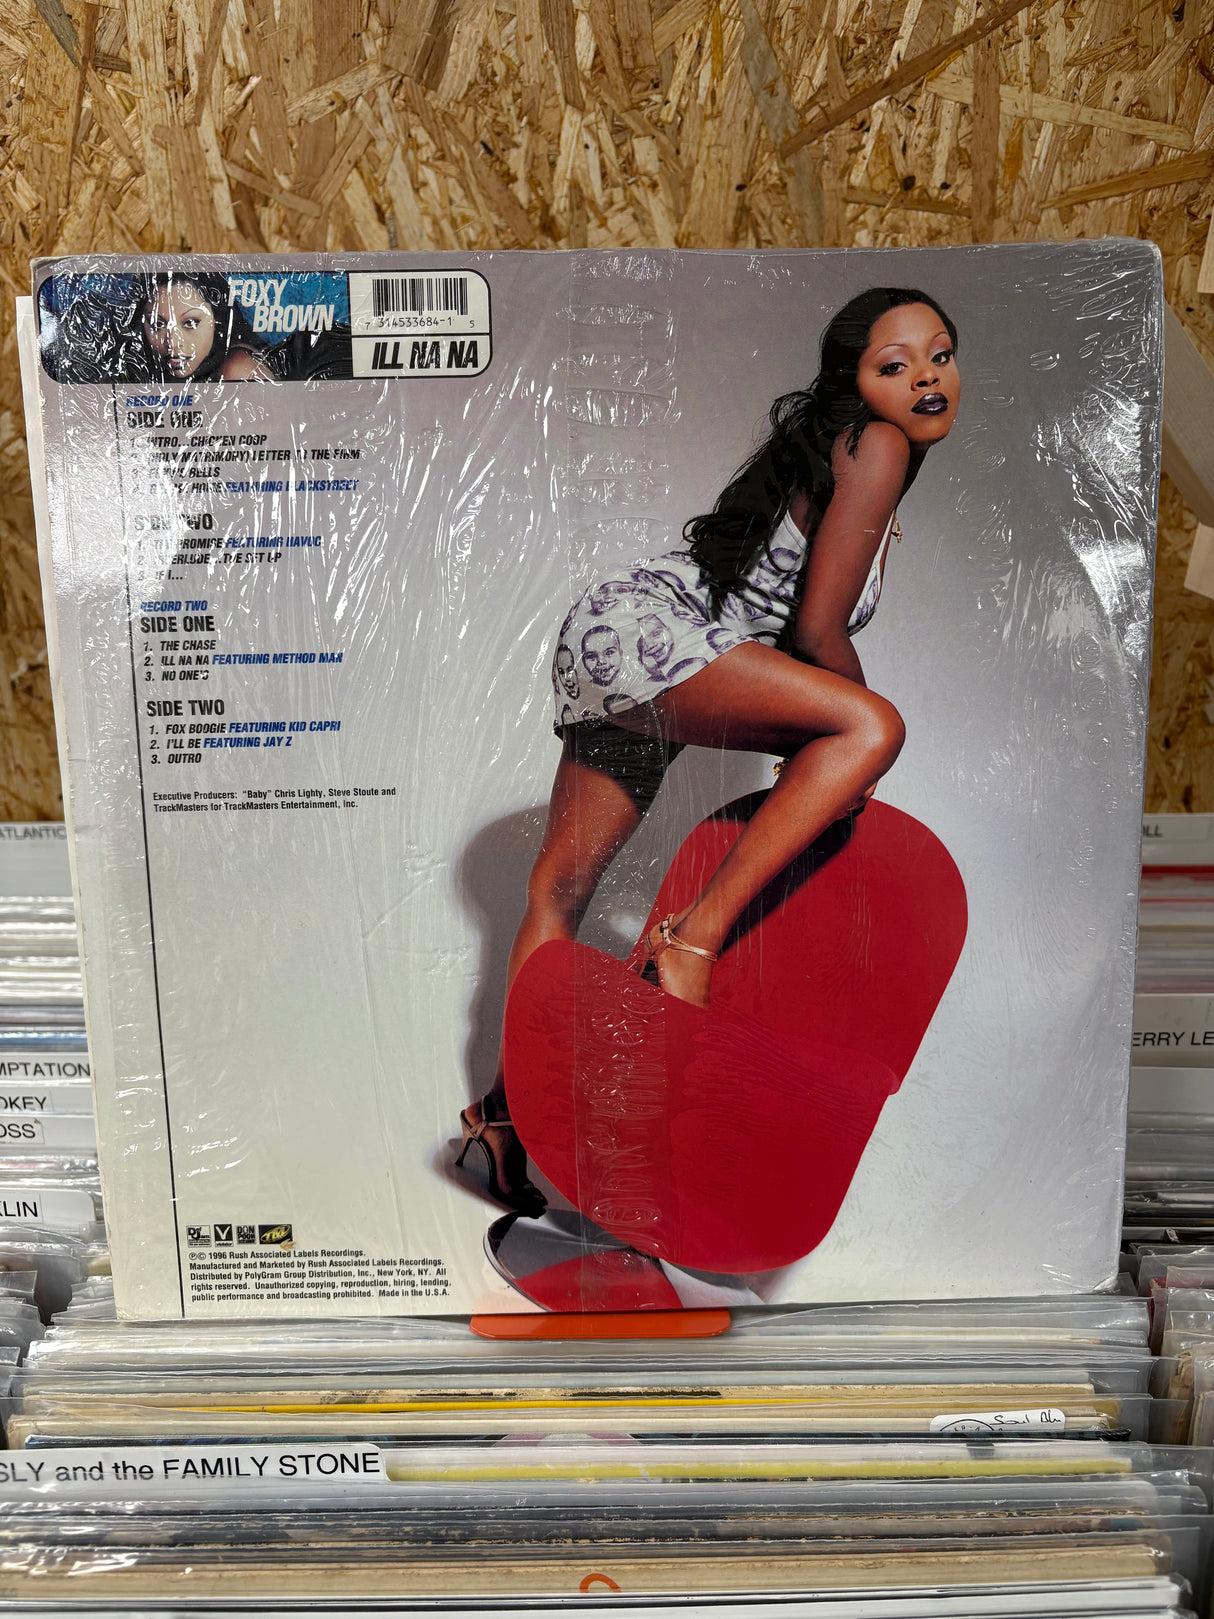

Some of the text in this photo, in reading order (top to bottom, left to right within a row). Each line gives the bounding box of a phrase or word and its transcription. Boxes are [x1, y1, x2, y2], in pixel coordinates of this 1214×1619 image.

[227, 279, 288, 308] FOXY
[252, 304, 335, 333] BROWN
[365, 317, 475, 330] 7 314533684-1 5
[371, 340, 479, 370] ILL NA NA
[126, 395, 193, 407] RECORD ONE
[127, 411, 203, 429] SIDE ONE
[239, 434, 267, 446] COOP
[252, 449, 291, 460] LETTER
[310, 449, 331, 460] THE
[333, 449, 361, 460] FIRM
[189, 466, 220, 478] BELLS
[225, 537, 283, 548] FEATURING
[245, 553, 264, 563] SET
[141, 600, 208, 612] RECORD TWO
[140, 615, 216, 633] SIDE ONE
[144, 640, 217, 652] 1. THE CHASE
[143, 652, 343, 667] 2. ILL NA NA FEATURING METHOD MAN
[144, 671, 155, 682] 3.
[161, 671, 177, 681] NO
[146, 699, 225, 717] SIDE TWO
[149, 721, 341, 735] 1. FOX BOOGIE FEATURING KID CAPRI
[149, 736, 293, 750] 2. I'LL BE FEATURING JAY Z
[151, 753, 202, 764] 3. OUTRO
[153, 791, 192, 801] Executive
[194, 790, 238, 799] Producers:
[274, 789, 296, 798] Chris
[297, 788, 326, 799] Lighty,
[328, 787, 351, 797] Steve
[353, 786, 379, 796] Stoute
[381, 787, 396, 796] and
[153, 800, 359, 812] TrackMasters for TrackMasters Entertainment, Inc.
[1143, 824, 1164, 838] LL
[1190, 1031, 1214, 1046] LE
[0, 1200, 38, 1217] LIN
[208, 1252, 227, 1260] 1996
[229, 1251, 248, 1259] Rush
[250, 1250, 291, 1259] Associated
[293, 1250, 319, 1258] Labels
[320, 1249, 366, 1258] Recordings.
[189, 1258, 445, 1270] Manufactured and Marketed by Rush Associated Labels Recordings.
[190, 1267, 447, 1281] Distributed by PolyGram Group Distribution, Inc., New York, NY. All
[191, 1278, 452, 1292] rights reserved. Unauthorized copying, reproduction, hiring, lending,
[191, 1287, 451, 1302] public performance and broadcasting prohibited. Made in the U.S.A.
[0, 1452, 380, 1482] SLY and the FAMILY STONE
